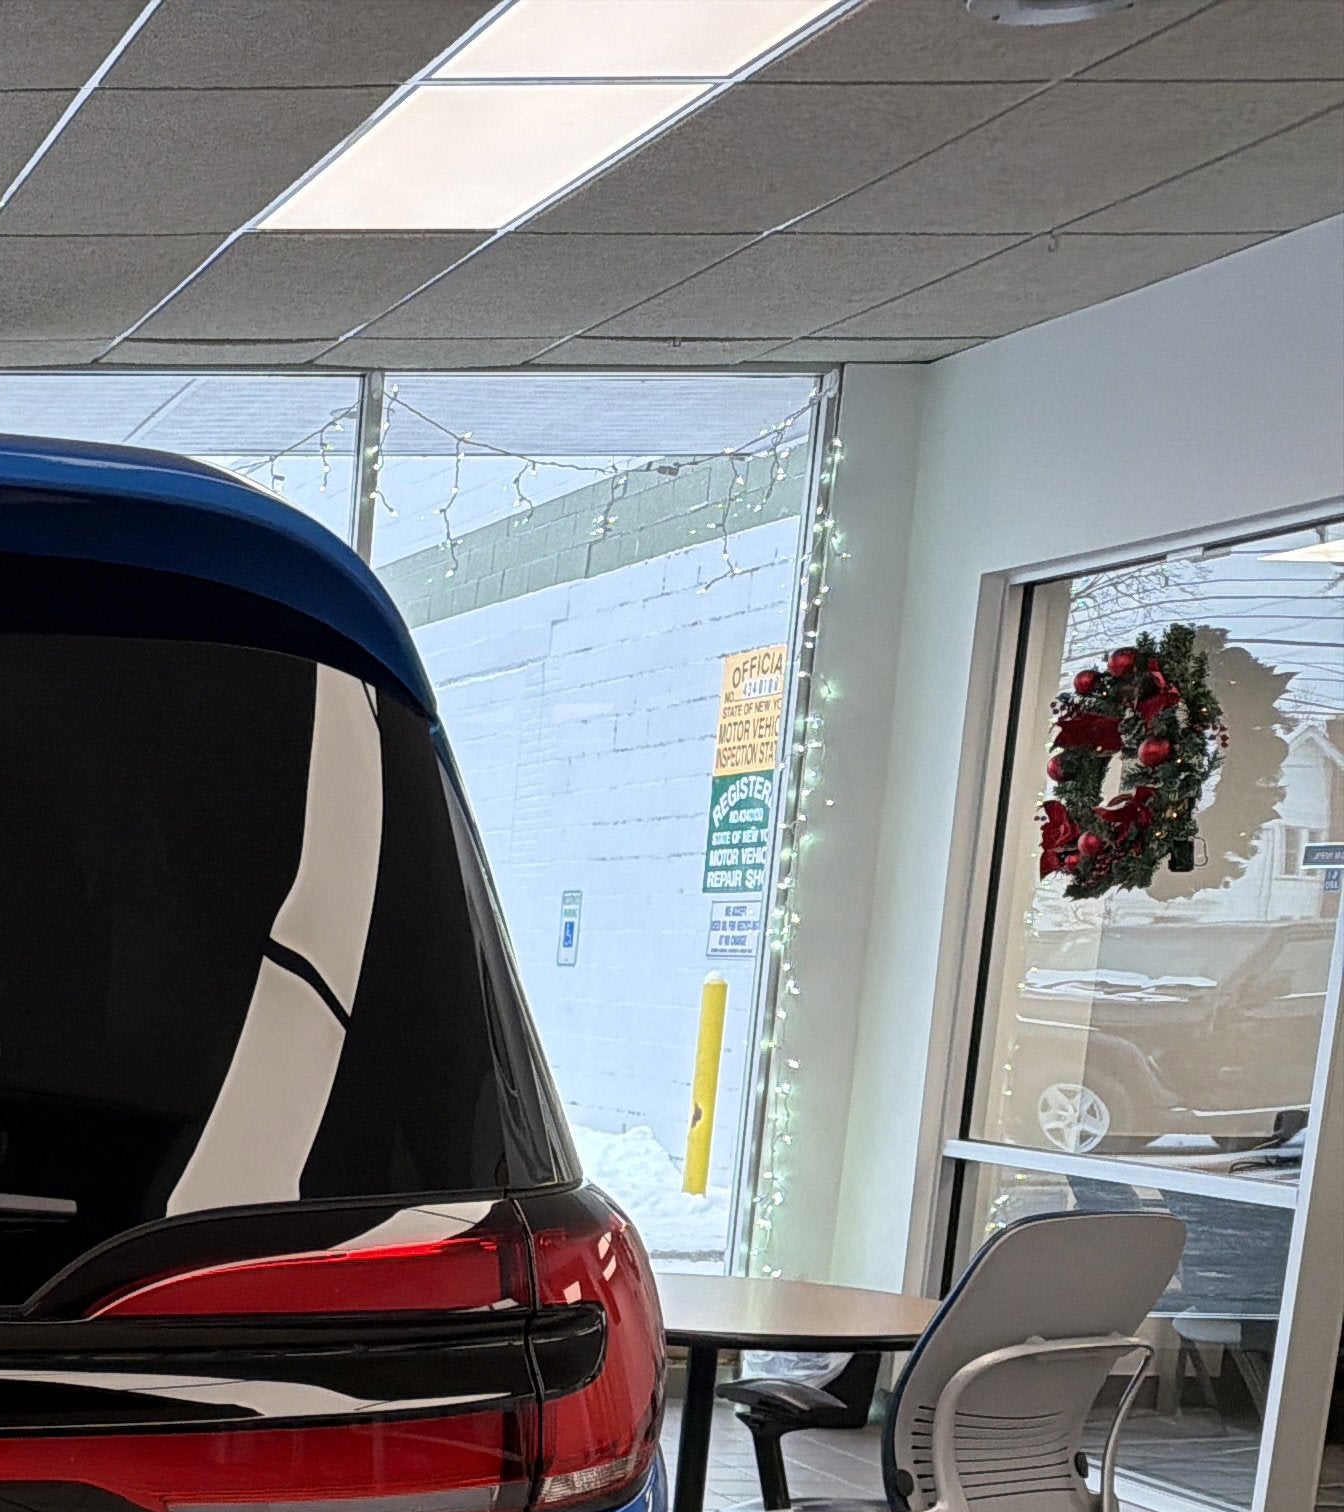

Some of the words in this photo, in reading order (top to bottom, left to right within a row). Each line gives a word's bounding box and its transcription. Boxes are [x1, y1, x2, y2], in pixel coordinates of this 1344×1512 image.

[722, 704, 743, 719] STATE
[743, 703, 753, 714] OF
[755, 700, 771, 713] NEW
[718, 719, 751, 745] MOTOR
[712, 775, 773, 828] REGISTER
[732, 830, 742, 844] OF
[709, 848, 740, 867] MOTOR
[707, 870, 743, 889] REPAIR
